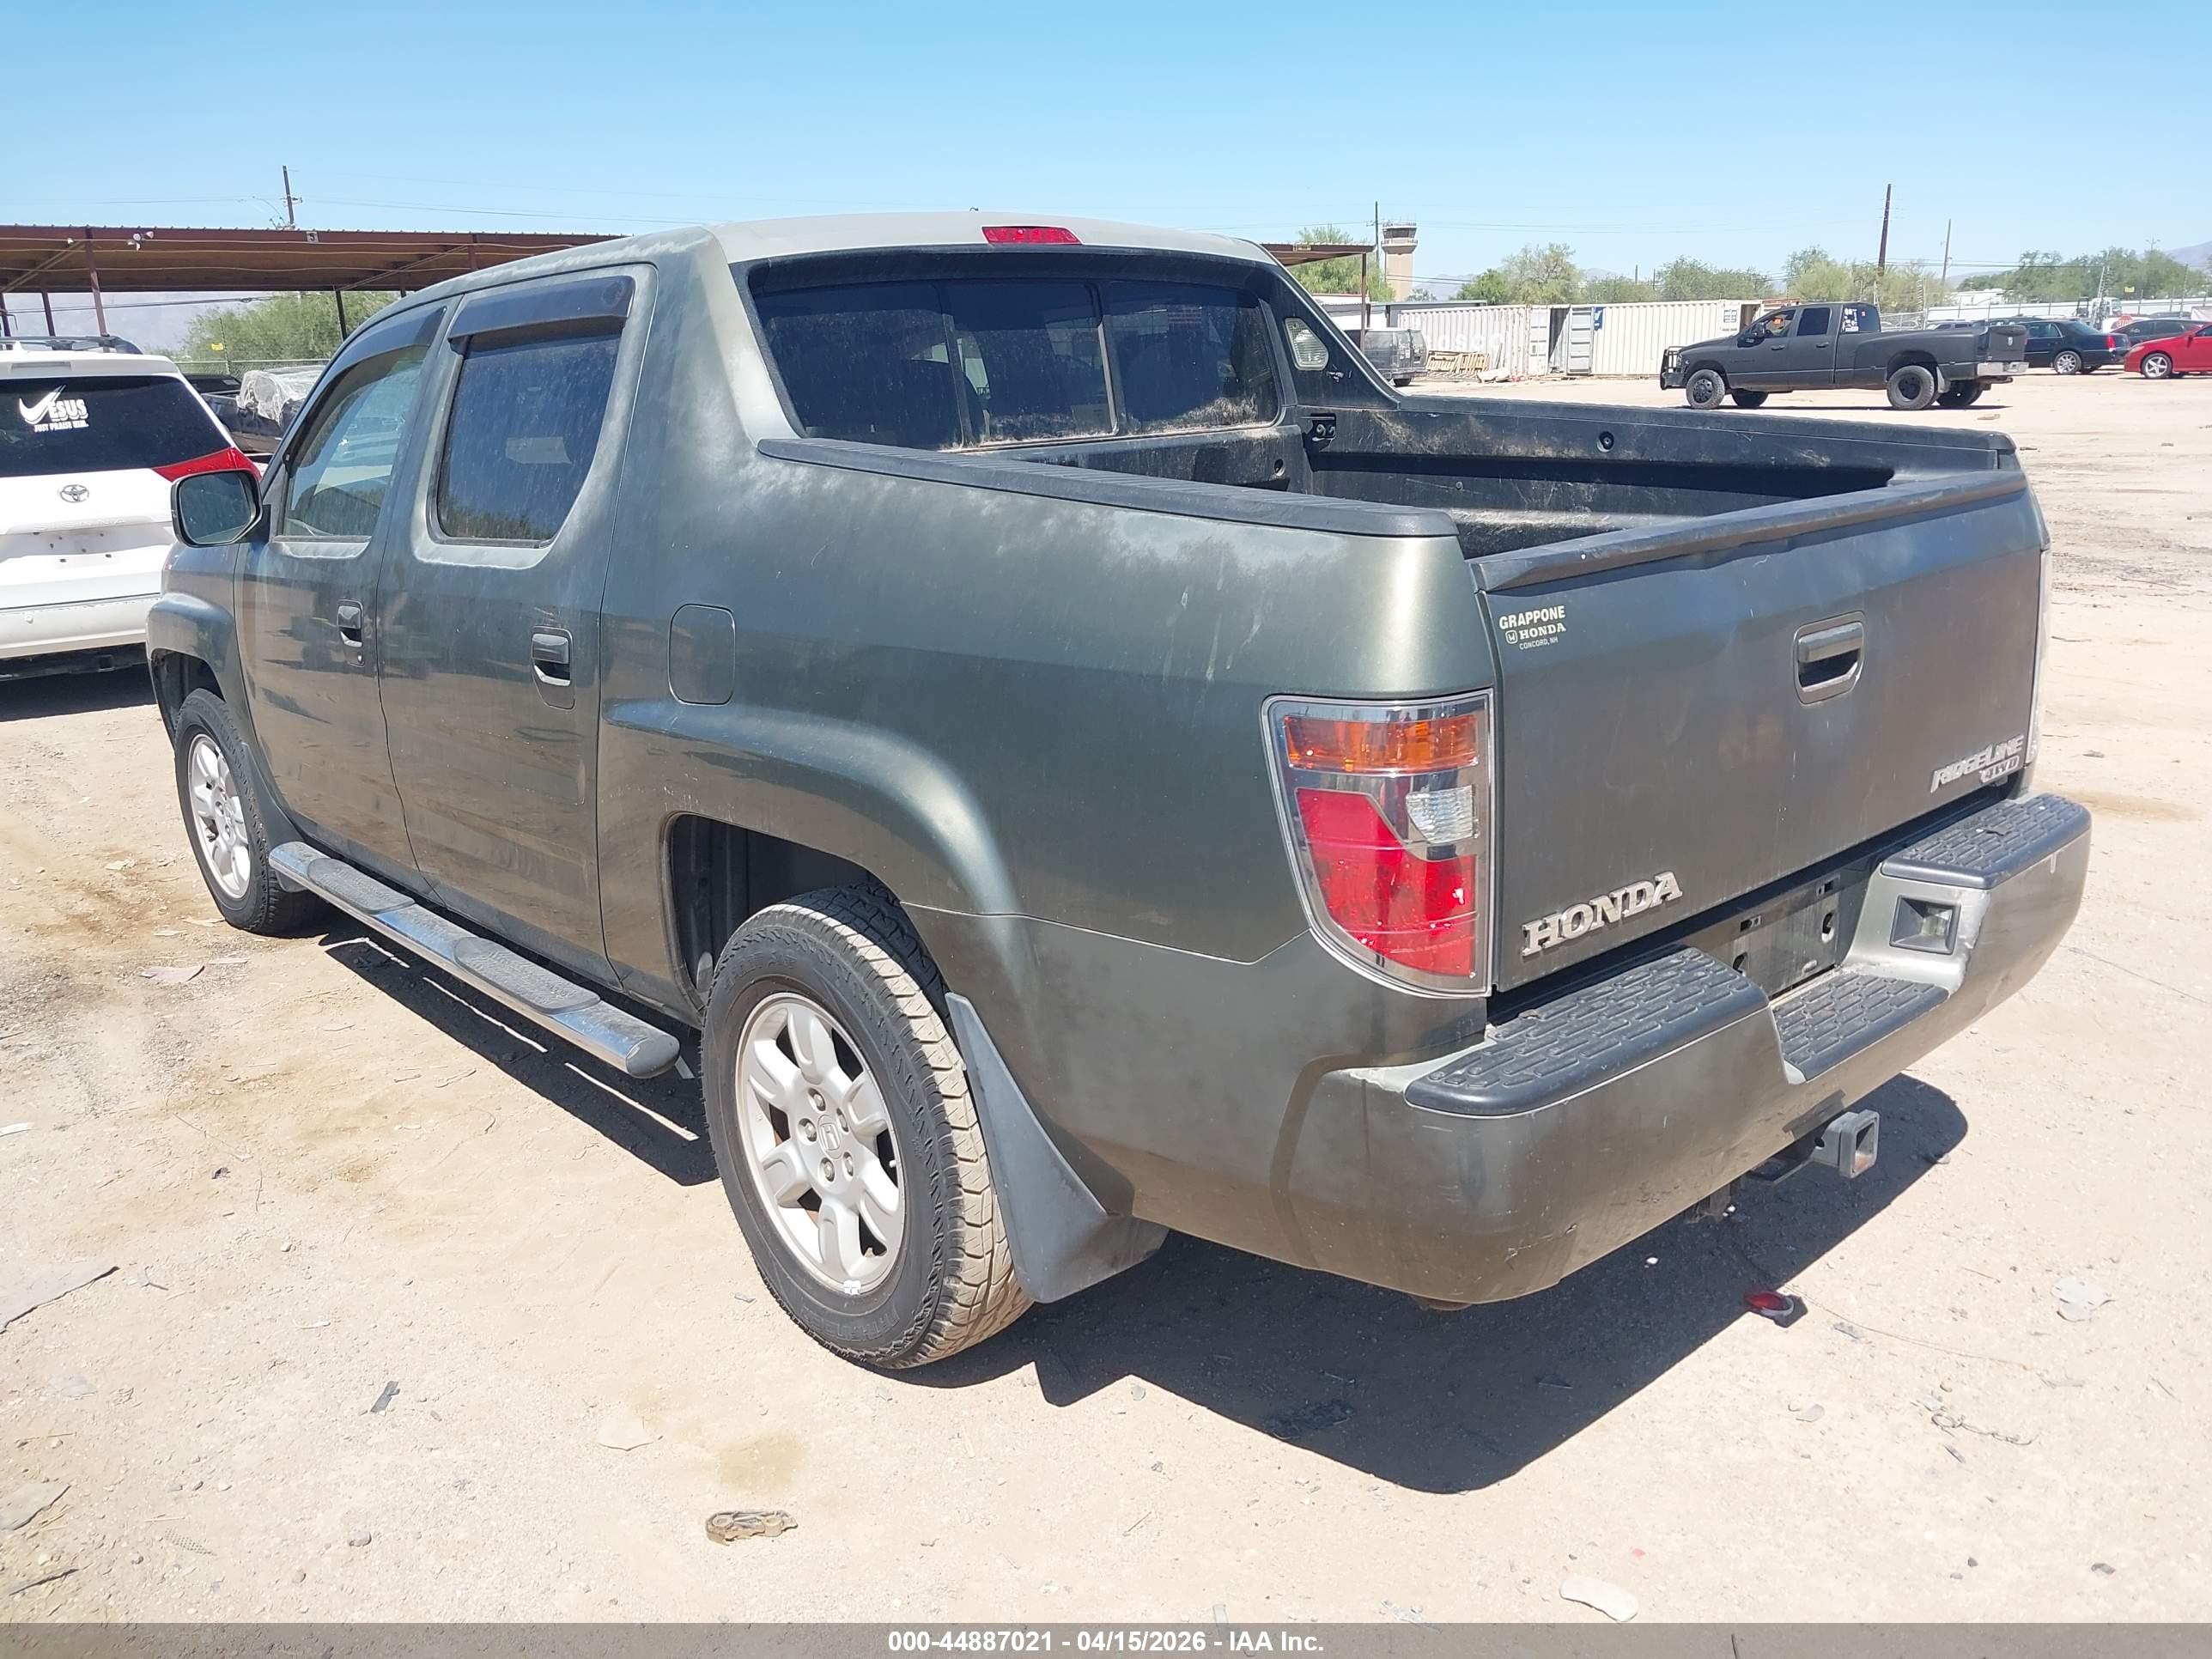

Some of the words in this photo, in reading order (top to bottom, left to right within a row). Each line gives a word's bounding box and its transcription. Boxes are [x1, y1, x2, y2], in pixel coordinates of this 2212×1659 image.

[1498, 605, 1565, 629] GRAPPONE
[1518, 623, 1566, 640] HONDA
[1518, 639, 1549, 650] CONCORD,
[1549, 636, 1559, 645] NH
[1929, 734, 2024, 793] RIDGELINE
[1521, 871, 1683, 957] HONDA
